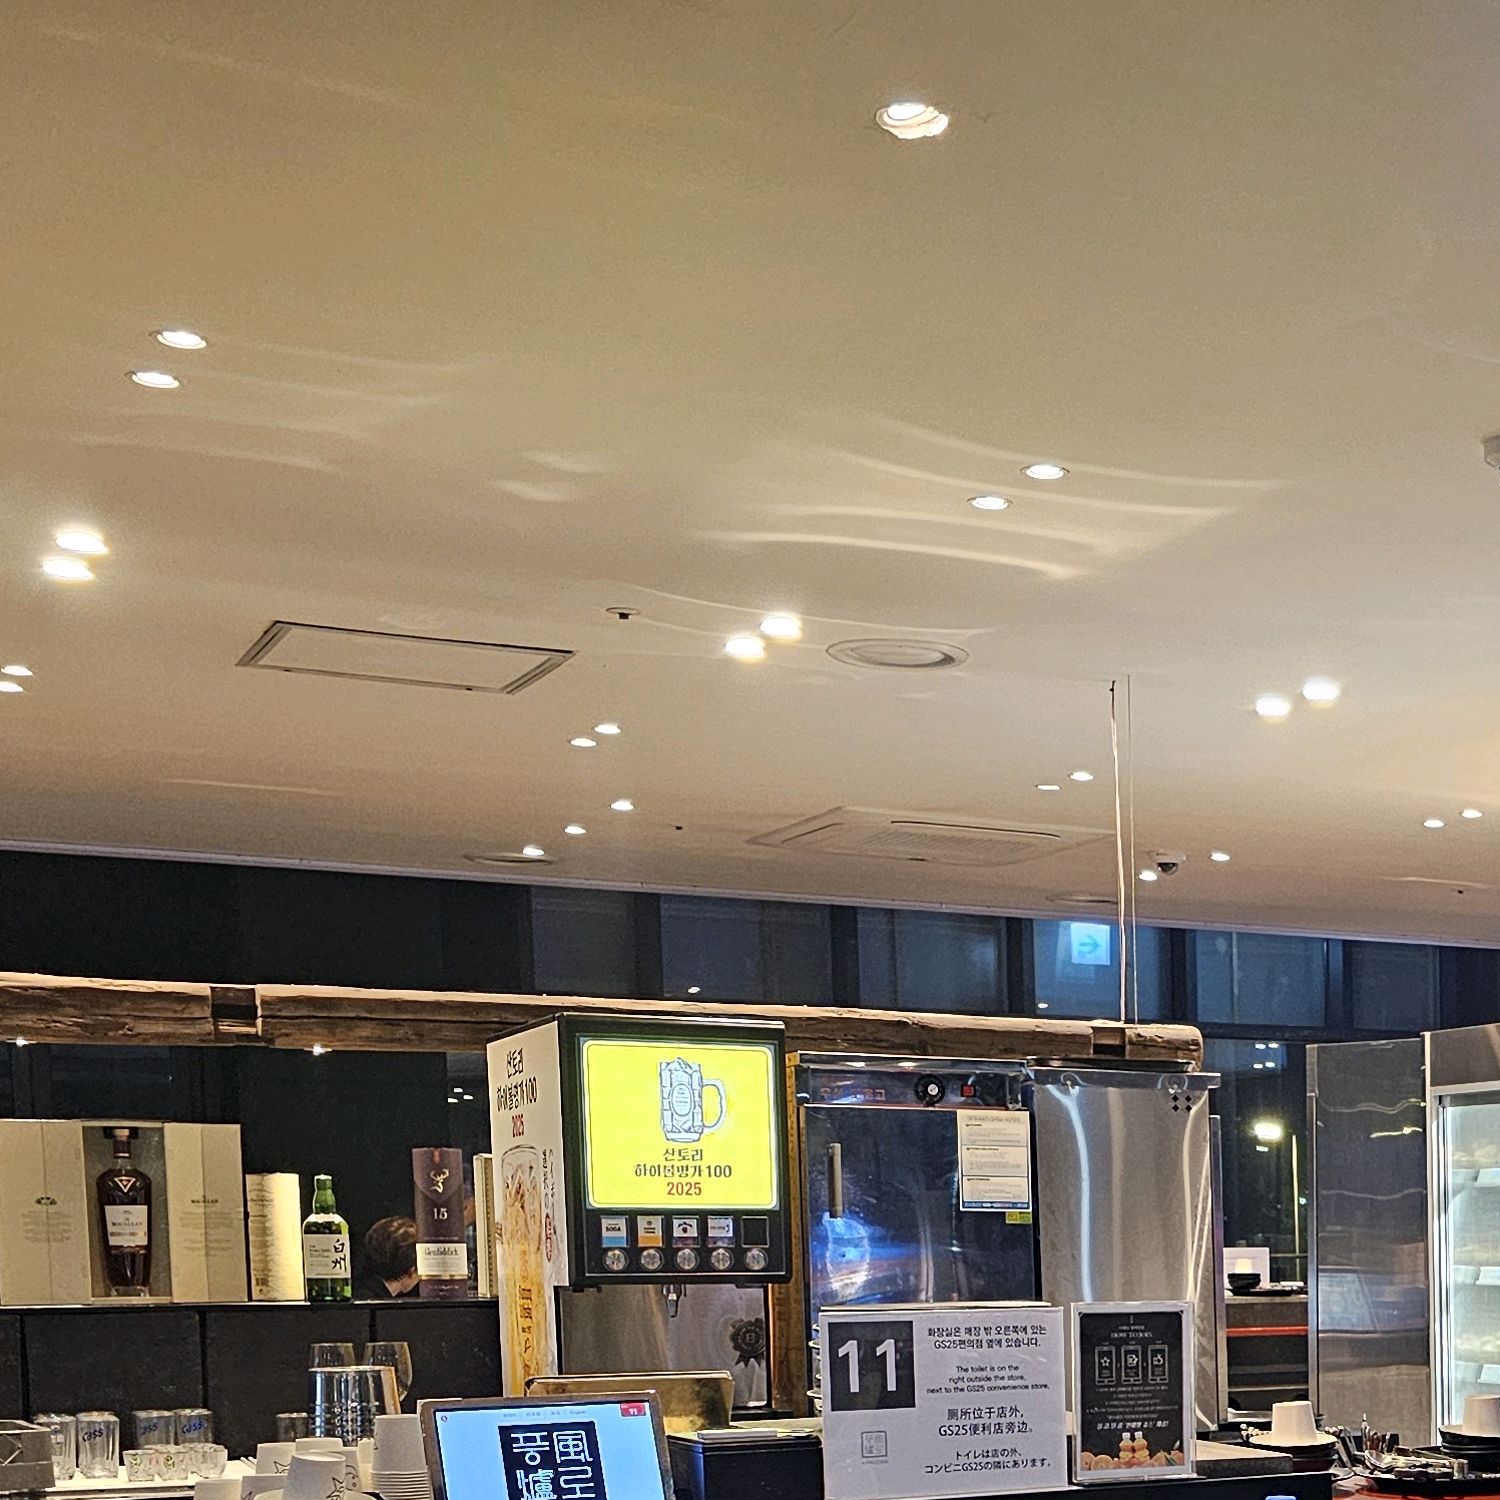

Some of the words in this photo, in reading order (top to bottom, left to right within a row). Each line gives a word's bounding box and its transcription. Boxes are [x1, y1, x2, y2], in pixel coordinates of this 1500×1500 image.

[505, 1047, 524, 1078] 산토리
[511, 1113, 525, 1138] 2025
[662, 1148, 703, 1162] 산토리
[666, 1181, 702, 1196] 2025
[433, 1207, 448, 1220] 15
[605, 1225, 622, 1233] SODA
[332, 1238, 347, 1273] 白州
[927, 1326, 961, 1338] 화장실은
[964, 1326, 981, 1337] 매장
[984, 1326, 992, 1336] 밖
[994, 1325, 1028, 1336] 오른쪽에
[1030, 1324, 1047, 1335] 있는
[933, 1339, 983, 1350] GS25편의점
[986, 1338, 1002, 1349] 옆에
[1005, 1337, 1041, 1348] 있습니다.
[838, 1338, 897, 1393] 11
[948, 1376, 965, 1385] right
[966, 1375, 992, 1383] outside
[966, 1385, 986, 1393] GS25
[986, 1384, 1030, 1392] convenience
[955, 1447, 1022, 1460] トイレは店の外、
